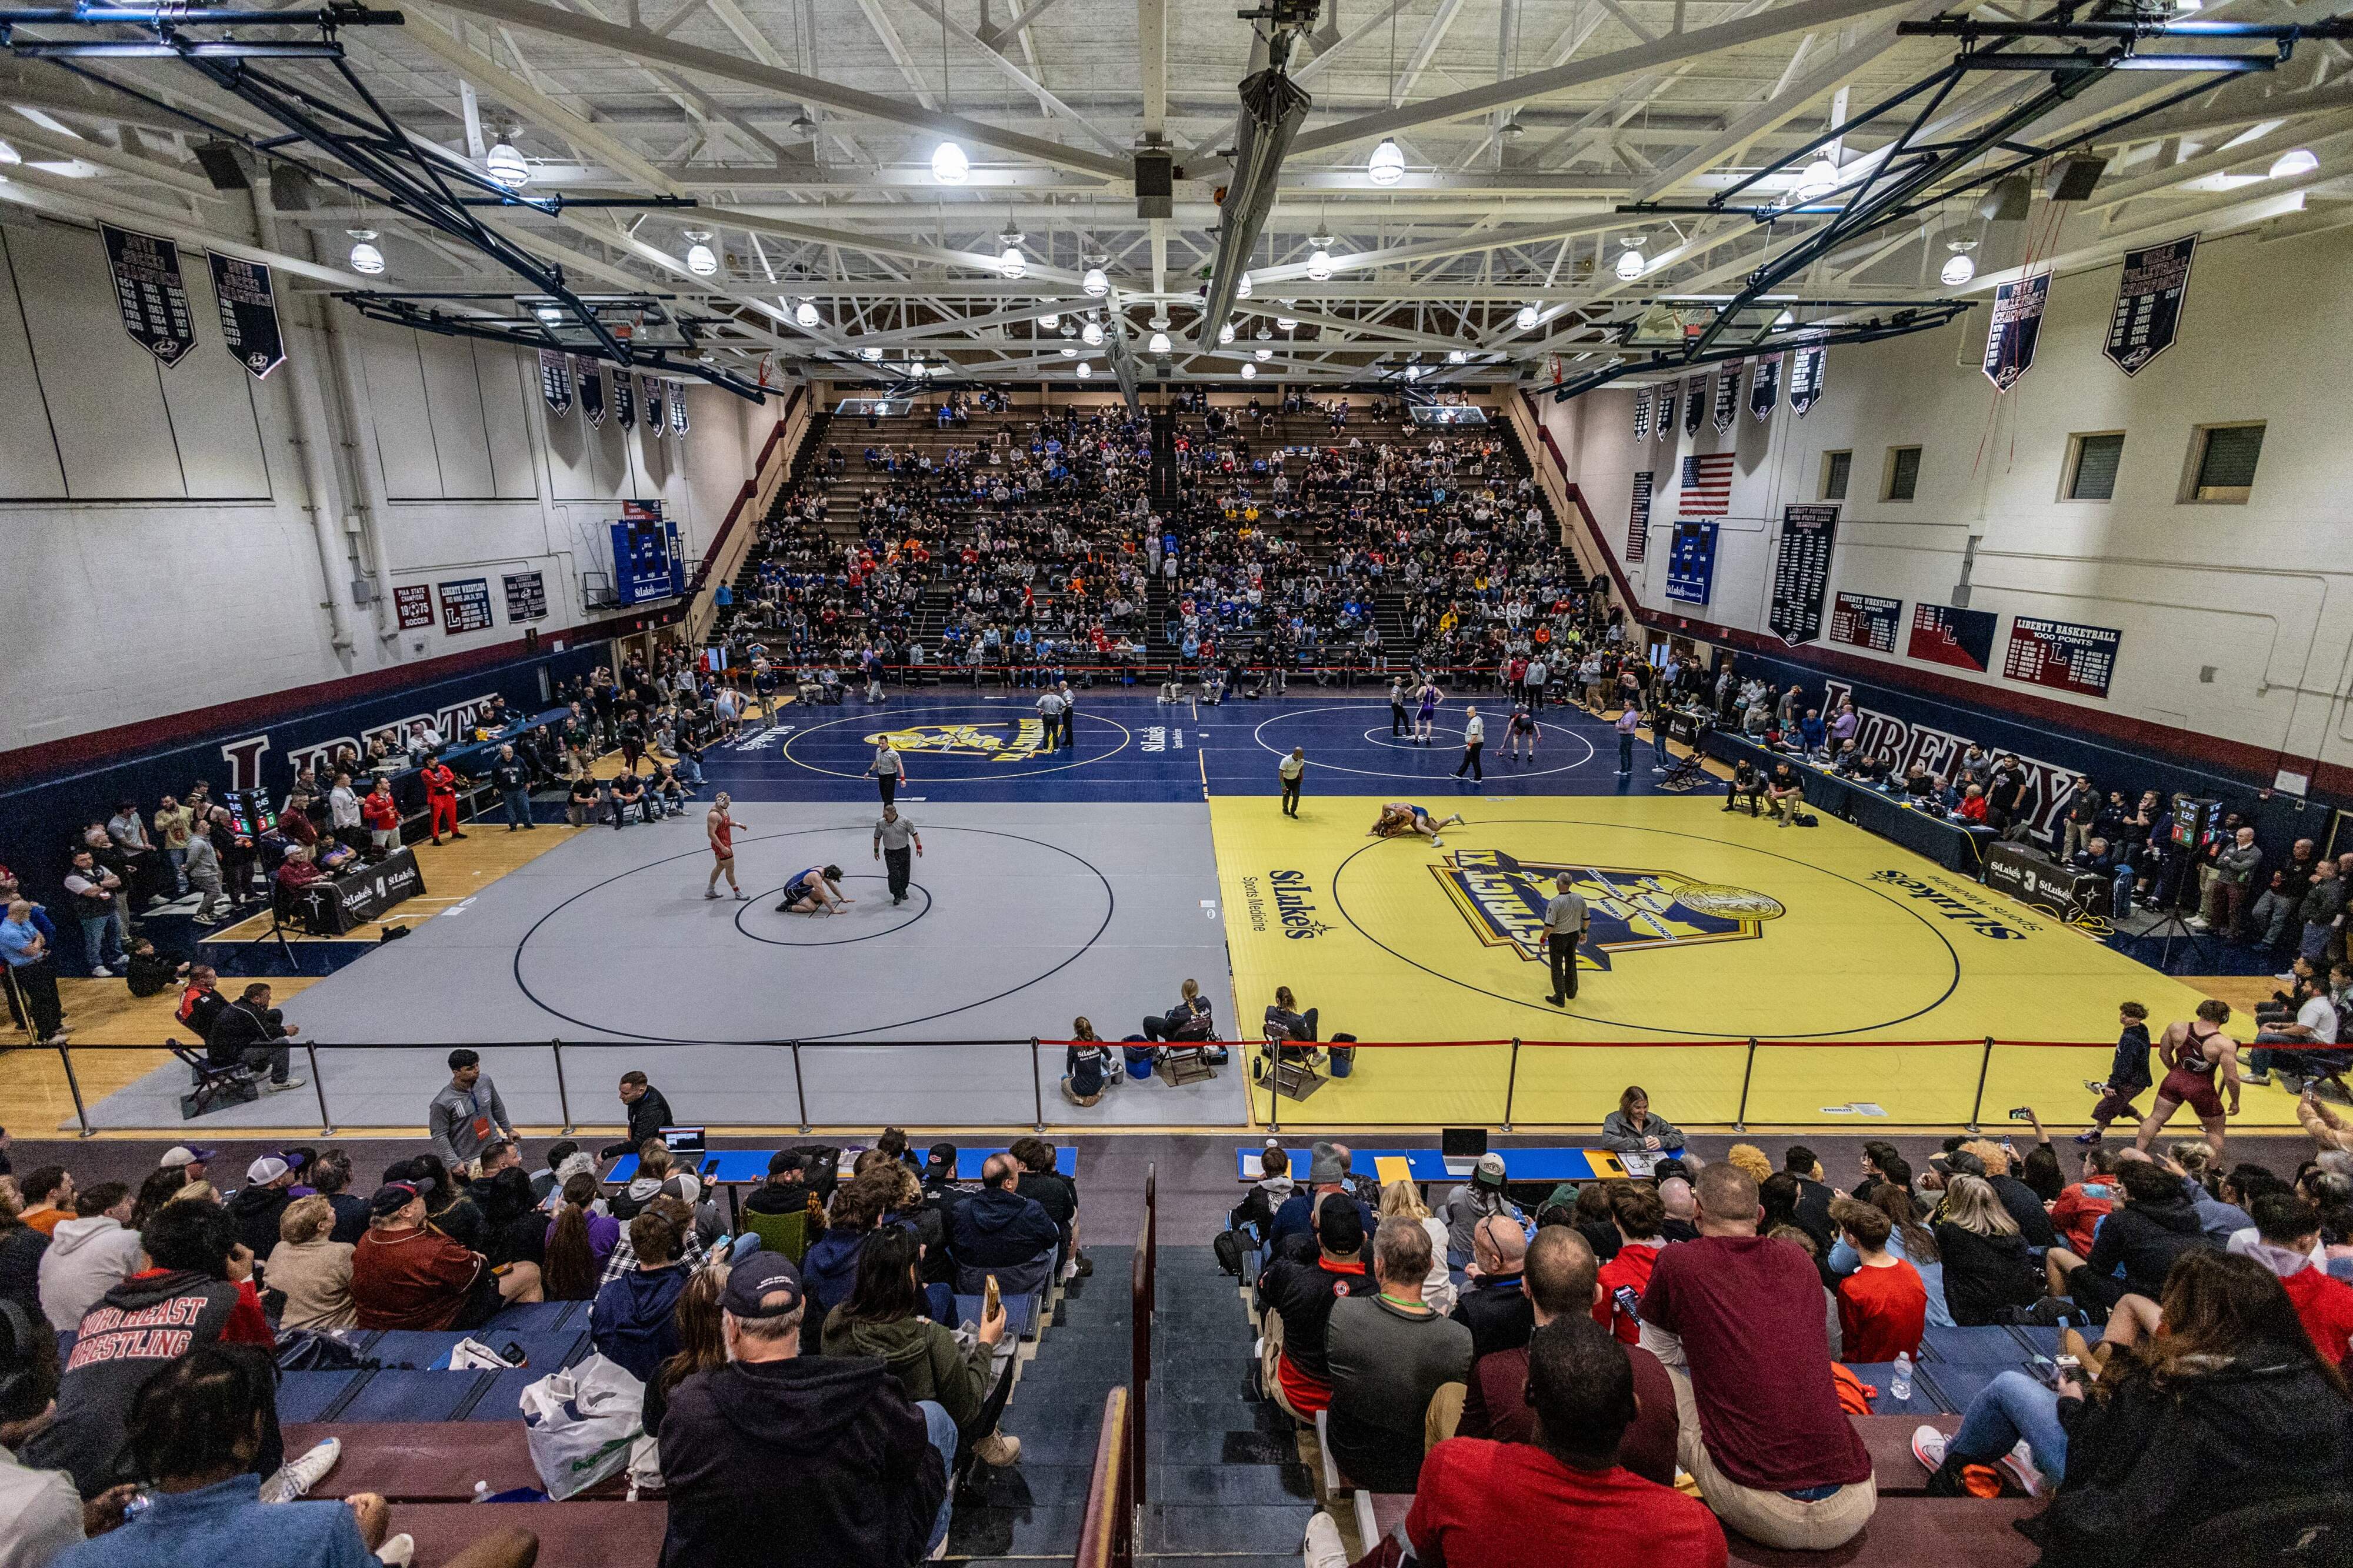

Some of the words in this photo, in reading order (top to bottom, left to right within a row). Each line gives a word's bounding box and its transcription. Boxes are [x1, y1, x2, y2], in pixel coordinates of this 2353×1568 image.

[2142, 245, 2177, 265] GIRLS
[2123, 255, 2188, 282] VOLLEYBALL
[2120, 271, 2185, 298] CHAMPIONS
[1996, 290, 2046, 313] VOLLEYBALL
[1994, 303, 2044, 324] CHAMPIONS
[2131, 323, 2149, 336] 2002
[401, 593, 424, 602] CHAMPIONS
[441, 586, 461, 596] LIBERTY
[461, 582, 486, 593] WRESTLING
[401, 605, 409, 616] 19
[418, 603, 429, 613] 75
[1840, 594, 1864, 604] LIBERTY
[1864, 597, 1897, 609] WRESTLING
[405, 616, 429, 627] SOCCER
[1858, 612, 1869, 629] L
[2017, 619, 2054, 633] LIBERTY
[2055, 625, 2116, 642] BASKETBALL
[1942, 625, 1957, 645] L
[2033, 632, 2055, 640] 1000
[2058, 636, 2094, 646] POINTS
[2049, 642, 2067, 665] L
[260, 820, 266, 829] 3
[268, 816, 274, 825] 0
[2185, 832, 2191, 842] 3
[1457, 850, 1499, 866] XI
[1522, 872, 1537, 881] PIKE
[1588, 869, 1624, 899] NORTHAMPTON
[1642, 877, 1664, 890] BUCKS
[2024, 870, 2036, 892] 3
[376, 876, 386, 899] 4
[1243, 876, 1258, 898] Sports
[1927, 875, 1991, 905] Medicine
[1599, 900, 1624, 919] CARBON
[1641, 895, 1665, 912] LEHIGH
[1247, 898, 1266, 932] Medicine
[1639, 910, 1677, 940] SCHUYLKILL
[1989, 906, 2044, 932] Sports
[65, 1329, 193, 1373] WRESTLING
